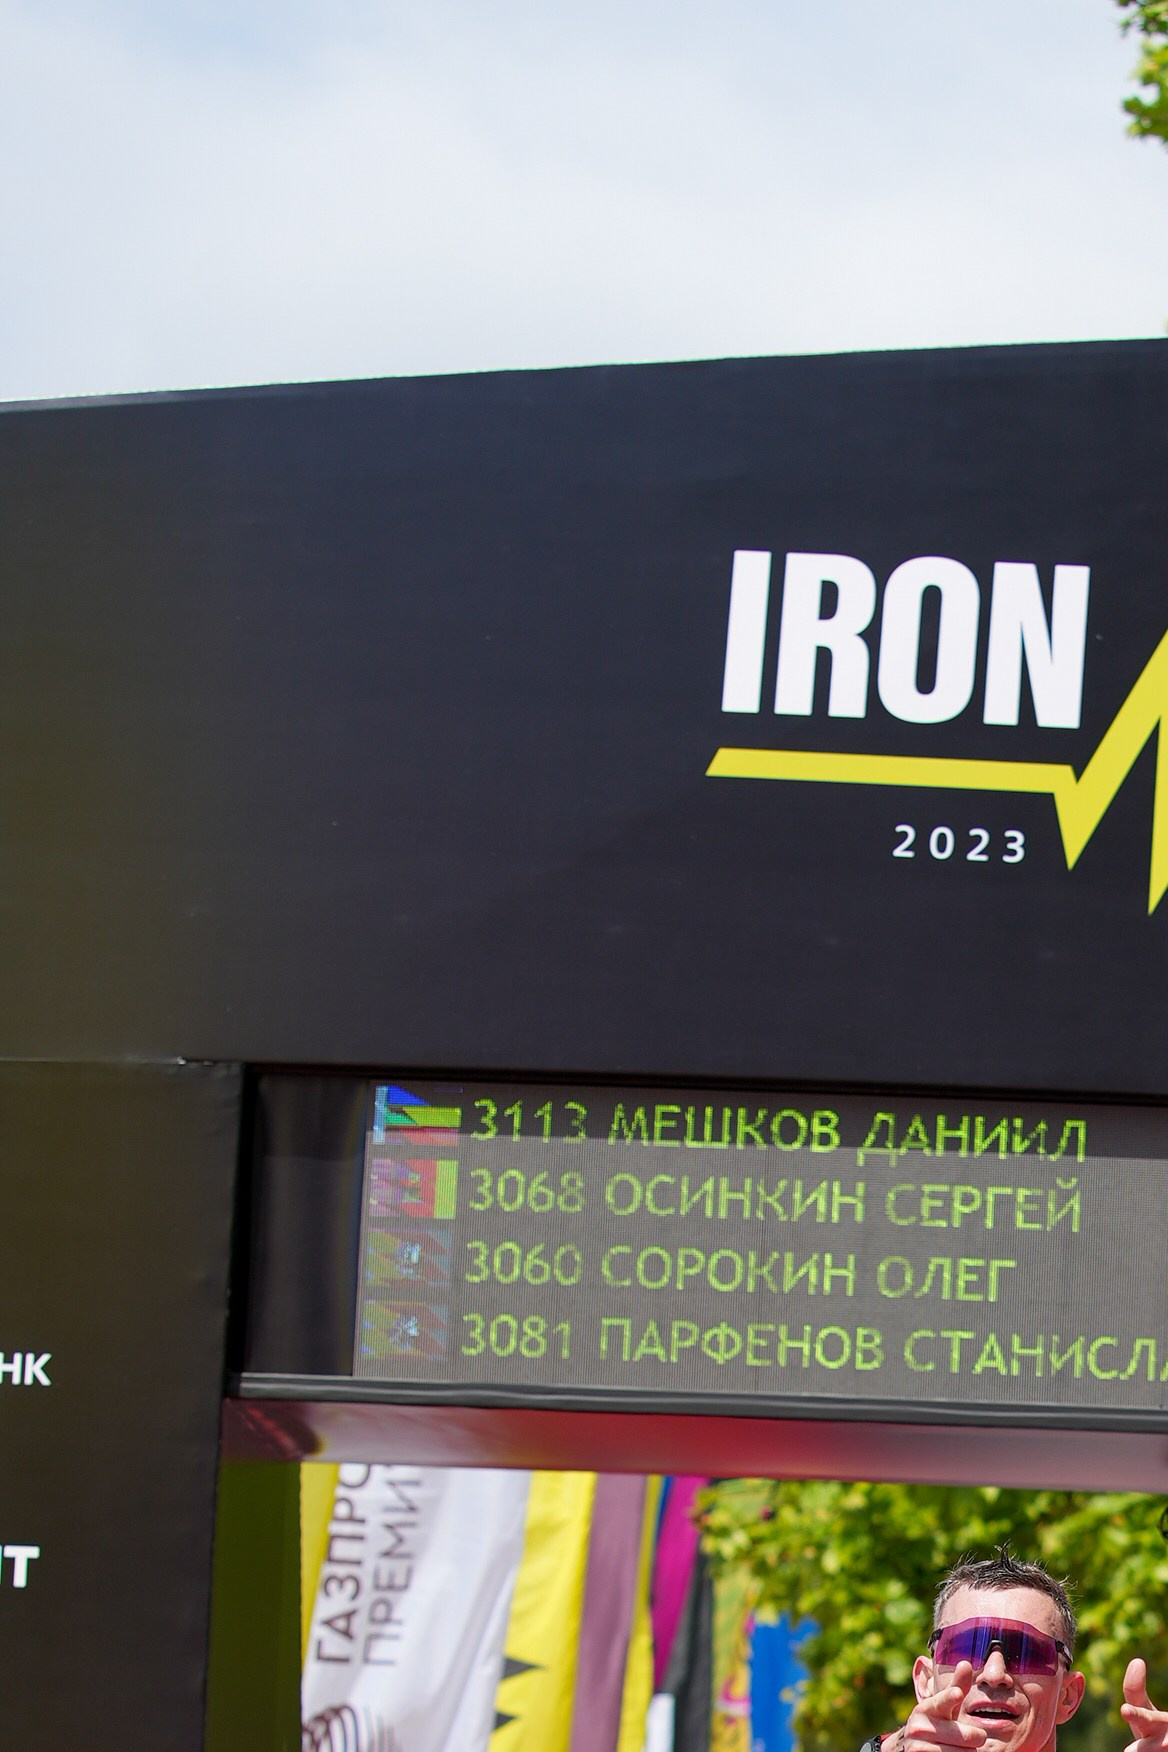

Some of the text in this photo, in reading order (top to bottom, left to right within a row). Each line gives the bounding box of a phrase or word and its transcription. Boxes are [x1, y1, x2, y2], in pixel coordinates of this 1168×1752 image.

[721, 549, 1091, 729] IRON
[892, 824, 1025, 863] 2023
[471, 1098, 588, 1144] 3113
[608, 1103, 842, 1154] МЕШКОВ
[857, 1110, 1088, 1167] ДАНИИЛ
[469, 1167, 587, 1214] 3068
[605, 1174, 866, 1226] ОСИНКИН
[884, 1176, 1083, 1234] СЕРГЕЙ
[465, 1241, 583, 1289] 3060
[601, 1246, 857, 1302] СОРОКИН
[876, 1256, 1019, 1304] ОЛЕГ
[461, 1313, 573, 1360] 3081
[599, 1317, 885, 1373] ПАРФЕНОВ
